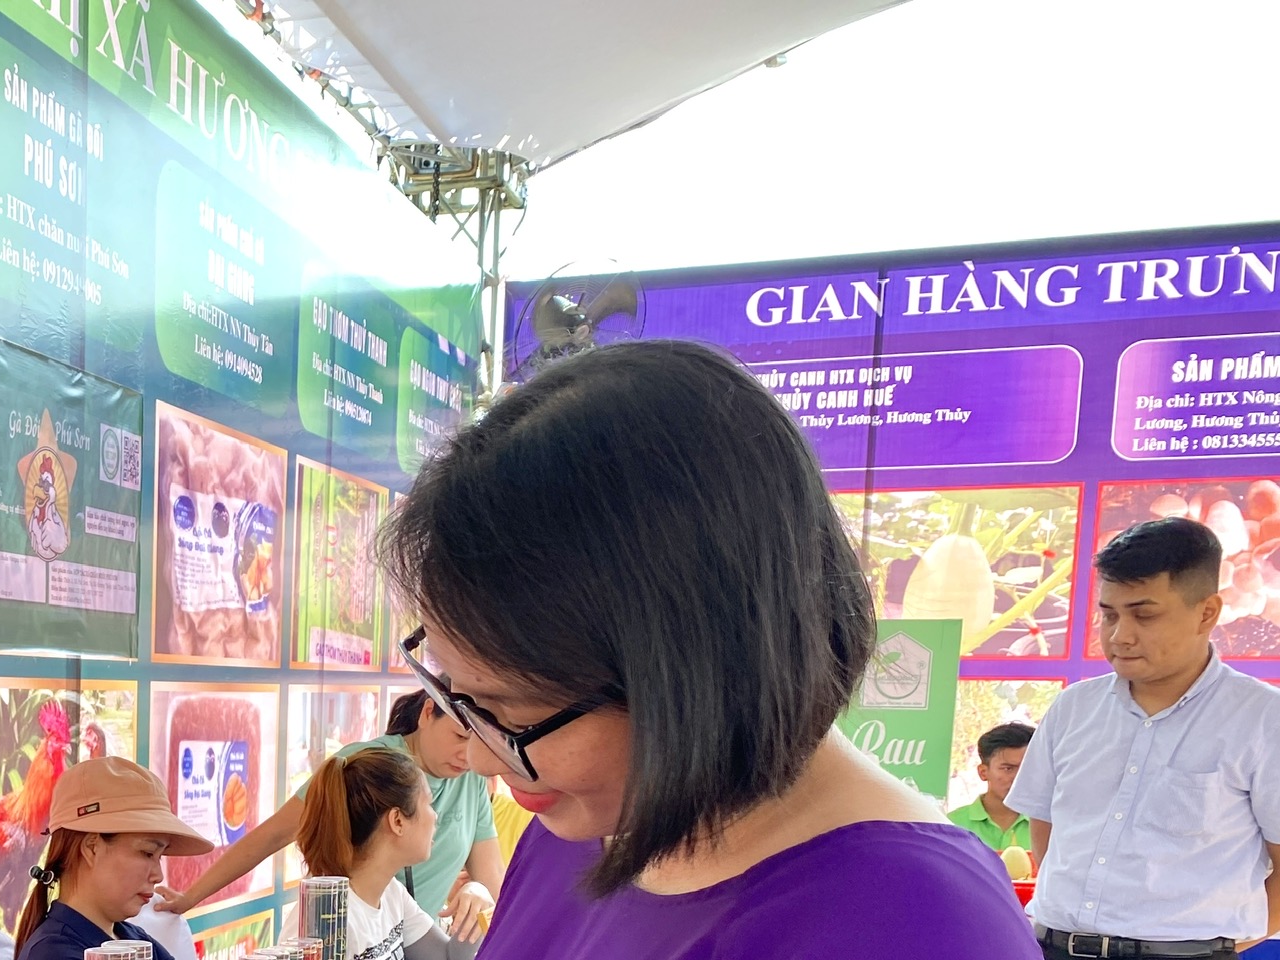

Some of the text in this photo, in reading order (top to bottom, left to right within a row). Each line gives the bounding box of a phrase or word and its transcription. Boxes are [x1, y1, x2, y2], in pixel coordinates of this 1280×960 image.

[4, 63, 28, 112] SẢN
[24, 133, 53, 189] PHÚ
[7, 193, 35, 231] HTX
[38, 214, 64, 246] chăn
[22, 248, 40, 282] hệ:
[43, 258, 102, 304] 091294005
[745, 278, 890, 328] GIAN
[903, 260, 1080, 316] HÀNG
[183, 290, 196, 318] Địa
[261, 333, 273, 356] Tân
[313, 296, 327, 334] GẠO
[368, 331, 388, 367] THANH
[195, 334, 211, 360] Liên
[213, 343, 224, 369] hệ:
[1171, 353, 1214, 383] SẢN
[790, 370, 826, 388] CANH
[829, 369, 855, 385] HTX
[858, 366, 890, 385] DỊCH
[894, 365, 913, 384] VỤ
[816, 389, 858, 409] CANH
[863, 384, 897, 407] HUẾ
[799, 407, 972, 429] Thủy Lương, Hương Thủy
[1134, 411, 1280, 431] Lương, Hương Thủ
[1135, 396, 1163, 412] Địa
[1198, 391, 1240, 407] HTX
[9, 410, 91, 451] Gà Đồi Phú Sơn
[1132, 438, 1167, 452] Liên
[1170, 436, 1189, 453] hệ
[853, 719, 927, 766] Rau
